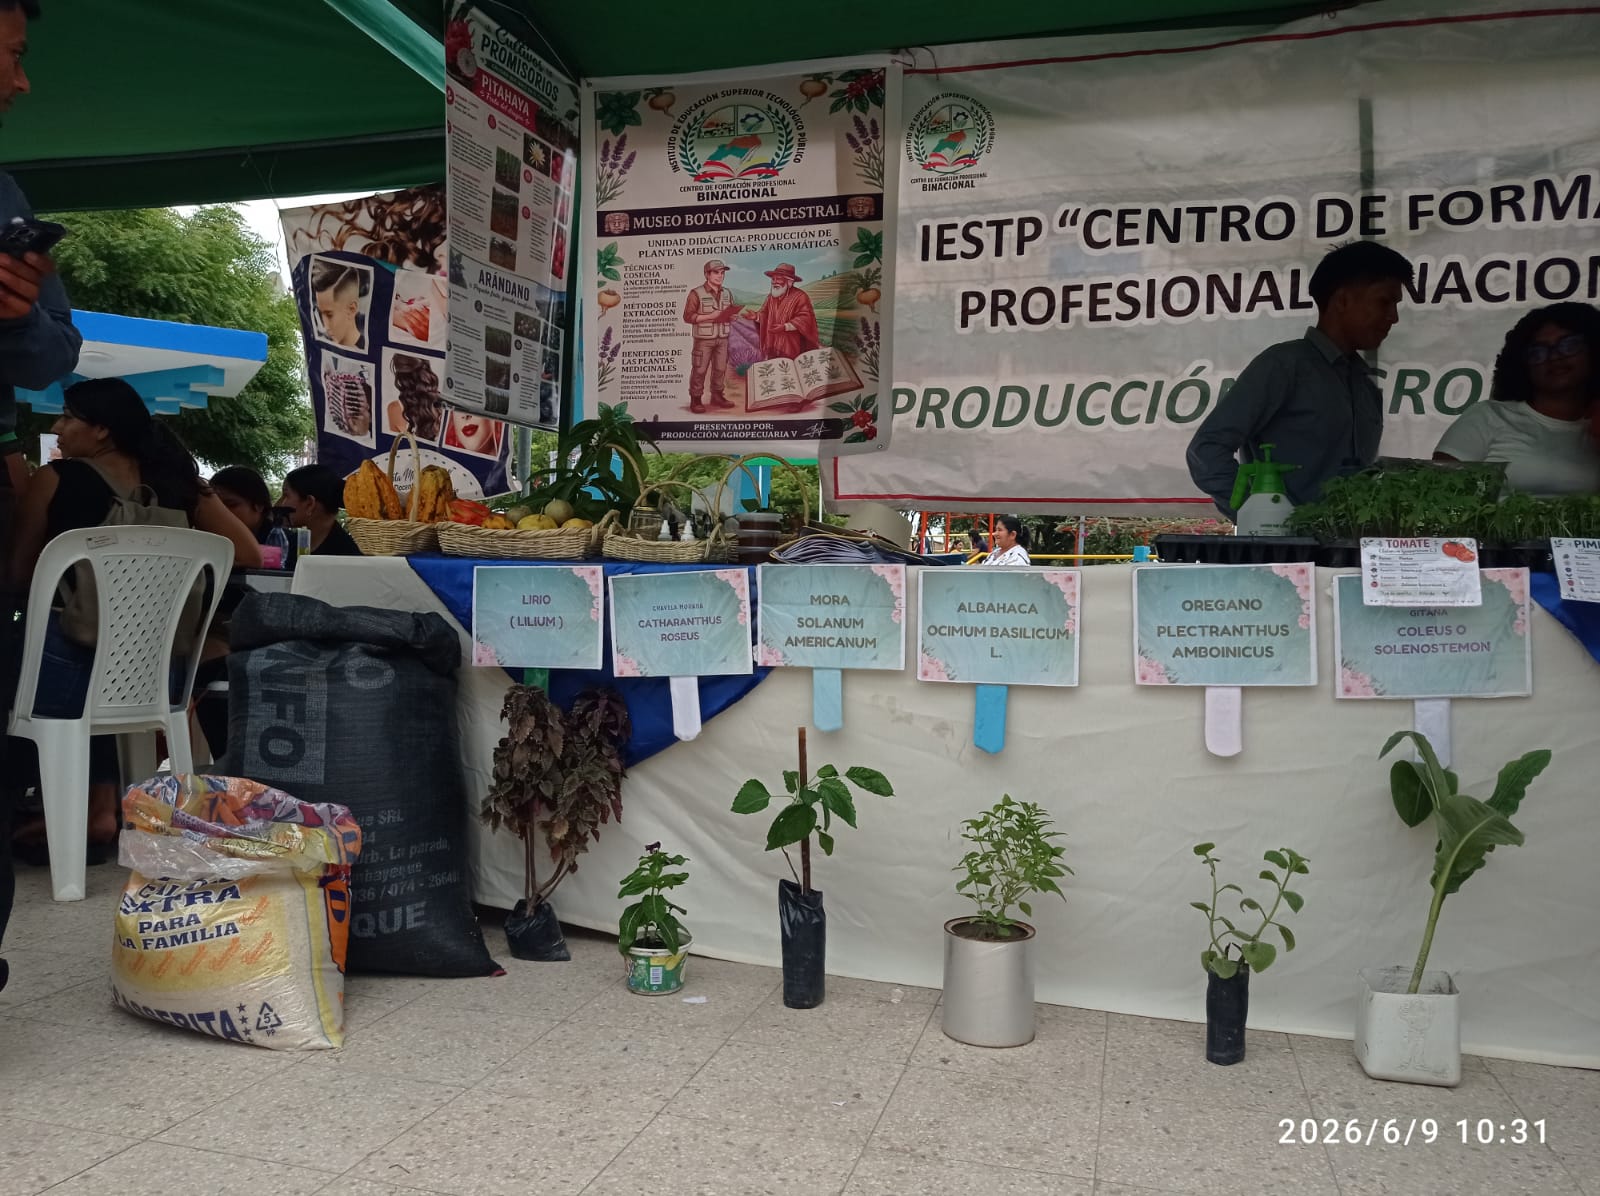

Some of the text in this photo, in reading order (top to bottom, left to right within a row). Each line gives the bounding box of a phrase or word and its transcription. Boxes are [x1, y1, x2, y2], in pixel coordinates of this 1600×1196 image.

[481, 34, 559, 101] PROMISORIOS
[481, 74, 530, 115] PITAHAYA
[667, 88, 808, 173] INSTITUTO DE EDUCACIÓN SUPERIOR TECNOLÓGICO PÚBLICO
[715, 181, 751, 190] FORMACIÓN
[752, 178, 796, 188] PROFESIONAL
[922, 180, 976, 192] BINACIONAL
[697, 187, 778, 202] BINACIONAL
[633, 204, 844, 230] MUSEO BOTÁNICO ANCESTRAL
[920, 216, 1043, 262] IESTP
[1316, 195, 1387, 239] DE
[1407, 174, 1600, 231] FORM
[647, 228, 832, 248] UNIDAD DIDÁCTICA: PRODUCCIÓN DE
[638, 238, 840, 258] PLANTAS MEDICINALES Y AROMÁTICAS
[624, 264, 662, 272] TÉCNICAS
[478, 269, 530, 301] ARÁNDANO
[624, 278, 670, 286] ANCESTRAL
[959, 255, 1600, 329] PROFESIONAL NACIO
[624, 302, 664, 310] MÉTODOS
[624, 308, 676, 318] EXTRACCIÓN
[622, 350, 670, 358] BENEFICIOS
[622, 364, 678, 373] MEDICINALES
[694, 422, 774, 431] PRESENTADO POR:
[661, 430, 798, 439] PRODUCCIÓN AGROPECUARIA V
[1385, 539, 1431, 548] TOMATE
[522, 594, 551, 605] LIRIO
[810, 595, 850, 606] MORA
[1181, 598, 1263, 612] OREGANO
[957, 602, 1038, 615] ALBAHACA
[1410, 608, 1448, 617] GITANA
[638, 616, 722, 628] CATHARANTHUS
[797, 617, 864, 629] SOLANUM
[660, 632, 700, 642] ROSEUS
[927, 624, 1070, 640] OCIMUM BASILICUM
[1157, 624, 1290, 638] PLECTRANTHUS
[1397, 624, 1467, 637] COLEUS O
[784, 636, 877, 649] AMERICANUM
[1374, 641, 1491, 655] SOLENOSTEMON
[990, 647, 1002, 658] L.
[1172, 646, 1274, 659] AMBOINICUS
[138, 912, 202, 934] PARA
[350, 901, 428, 938] QUE
[118, 921, 240, 950] LA FAMILIA
[264, 1012, 271, 1024] 5
